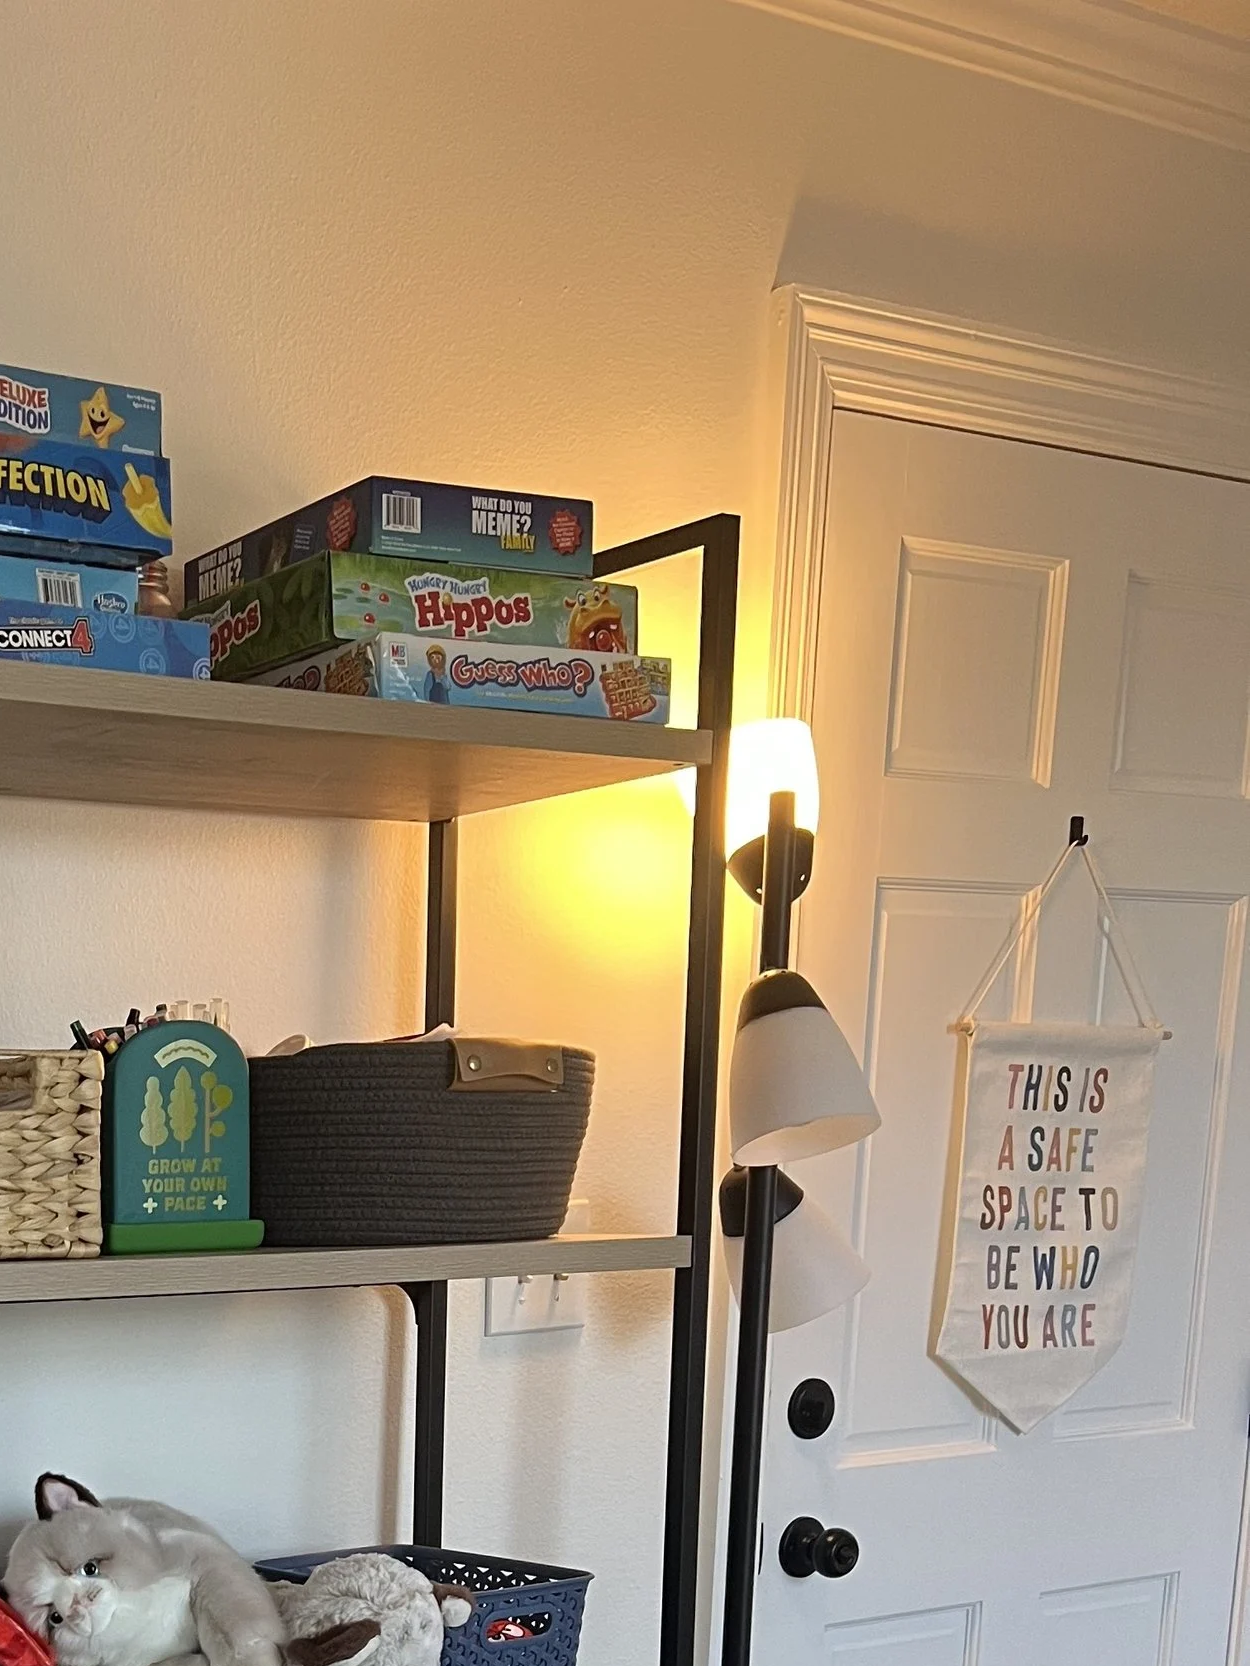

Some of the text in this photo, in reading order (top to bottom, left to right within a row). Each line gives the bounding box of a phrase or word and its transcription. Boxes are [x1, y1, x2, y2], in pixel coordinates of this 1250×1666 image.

[471, 495, 532, 516] WHAT DO YOU
[471, 510, 532, 537] MEME?
[501, 534, 536, 553] FAMILY
[408, 576, 488, 596] HUNGRY HUNGRY
[71, 619, 93, 653] 4
[1007, 1063, 1109, 1114] THIS IS
[997, 1124, 1099, 1173] A SAFE
[147, 1157, 223, 1175] GROW AT
[141, 1175, 227, 1194] YOUR OWN
[163, 1195, 207, 1212] PACE
[979, 1184, 1119, 1232] SPACE TO
[986, 1244, 1100, 1291] BE WHO
[981, 1302, 1097, 1350] YOU ARE
